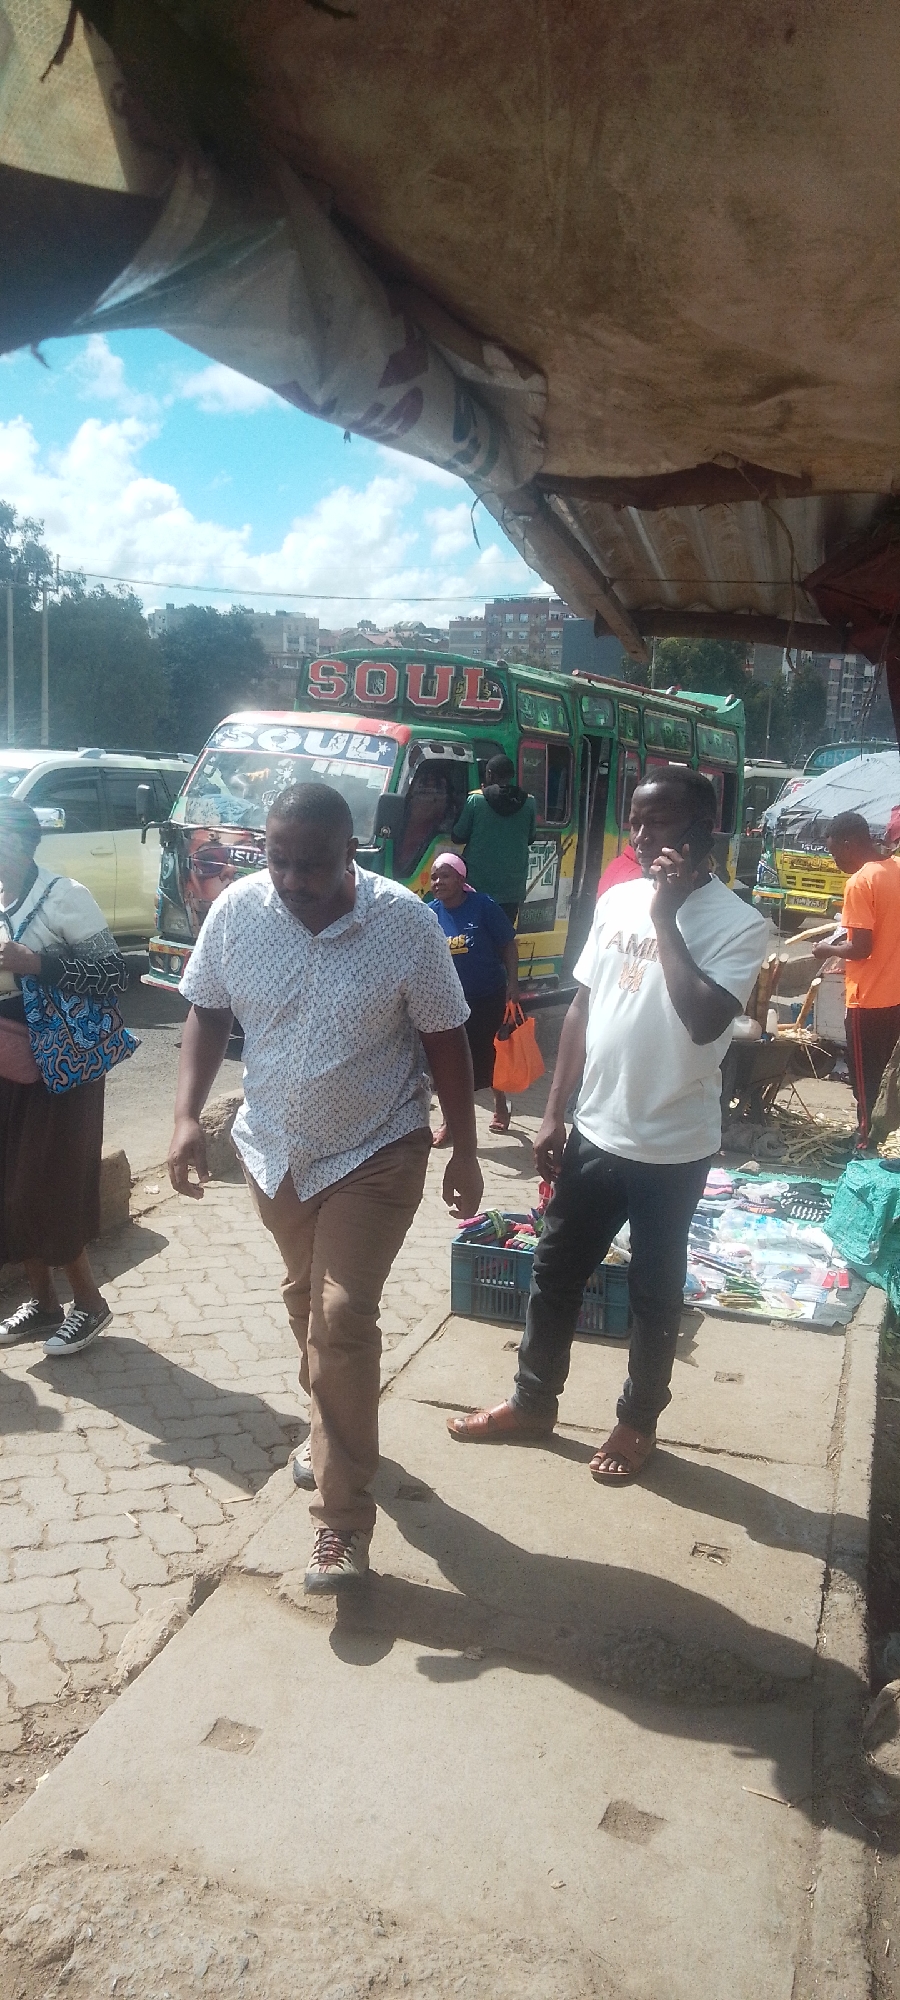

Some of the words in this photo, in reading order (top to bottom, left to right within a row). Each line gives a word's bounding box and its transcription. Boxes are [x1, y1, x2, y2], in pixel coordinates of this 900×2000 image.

[307, 659, 503, 711] SOUL
[213, 725, 380, 762] SOUL
[230, 849, 268, 866] ISUZ
[605, 930, 658, 962] AMI
